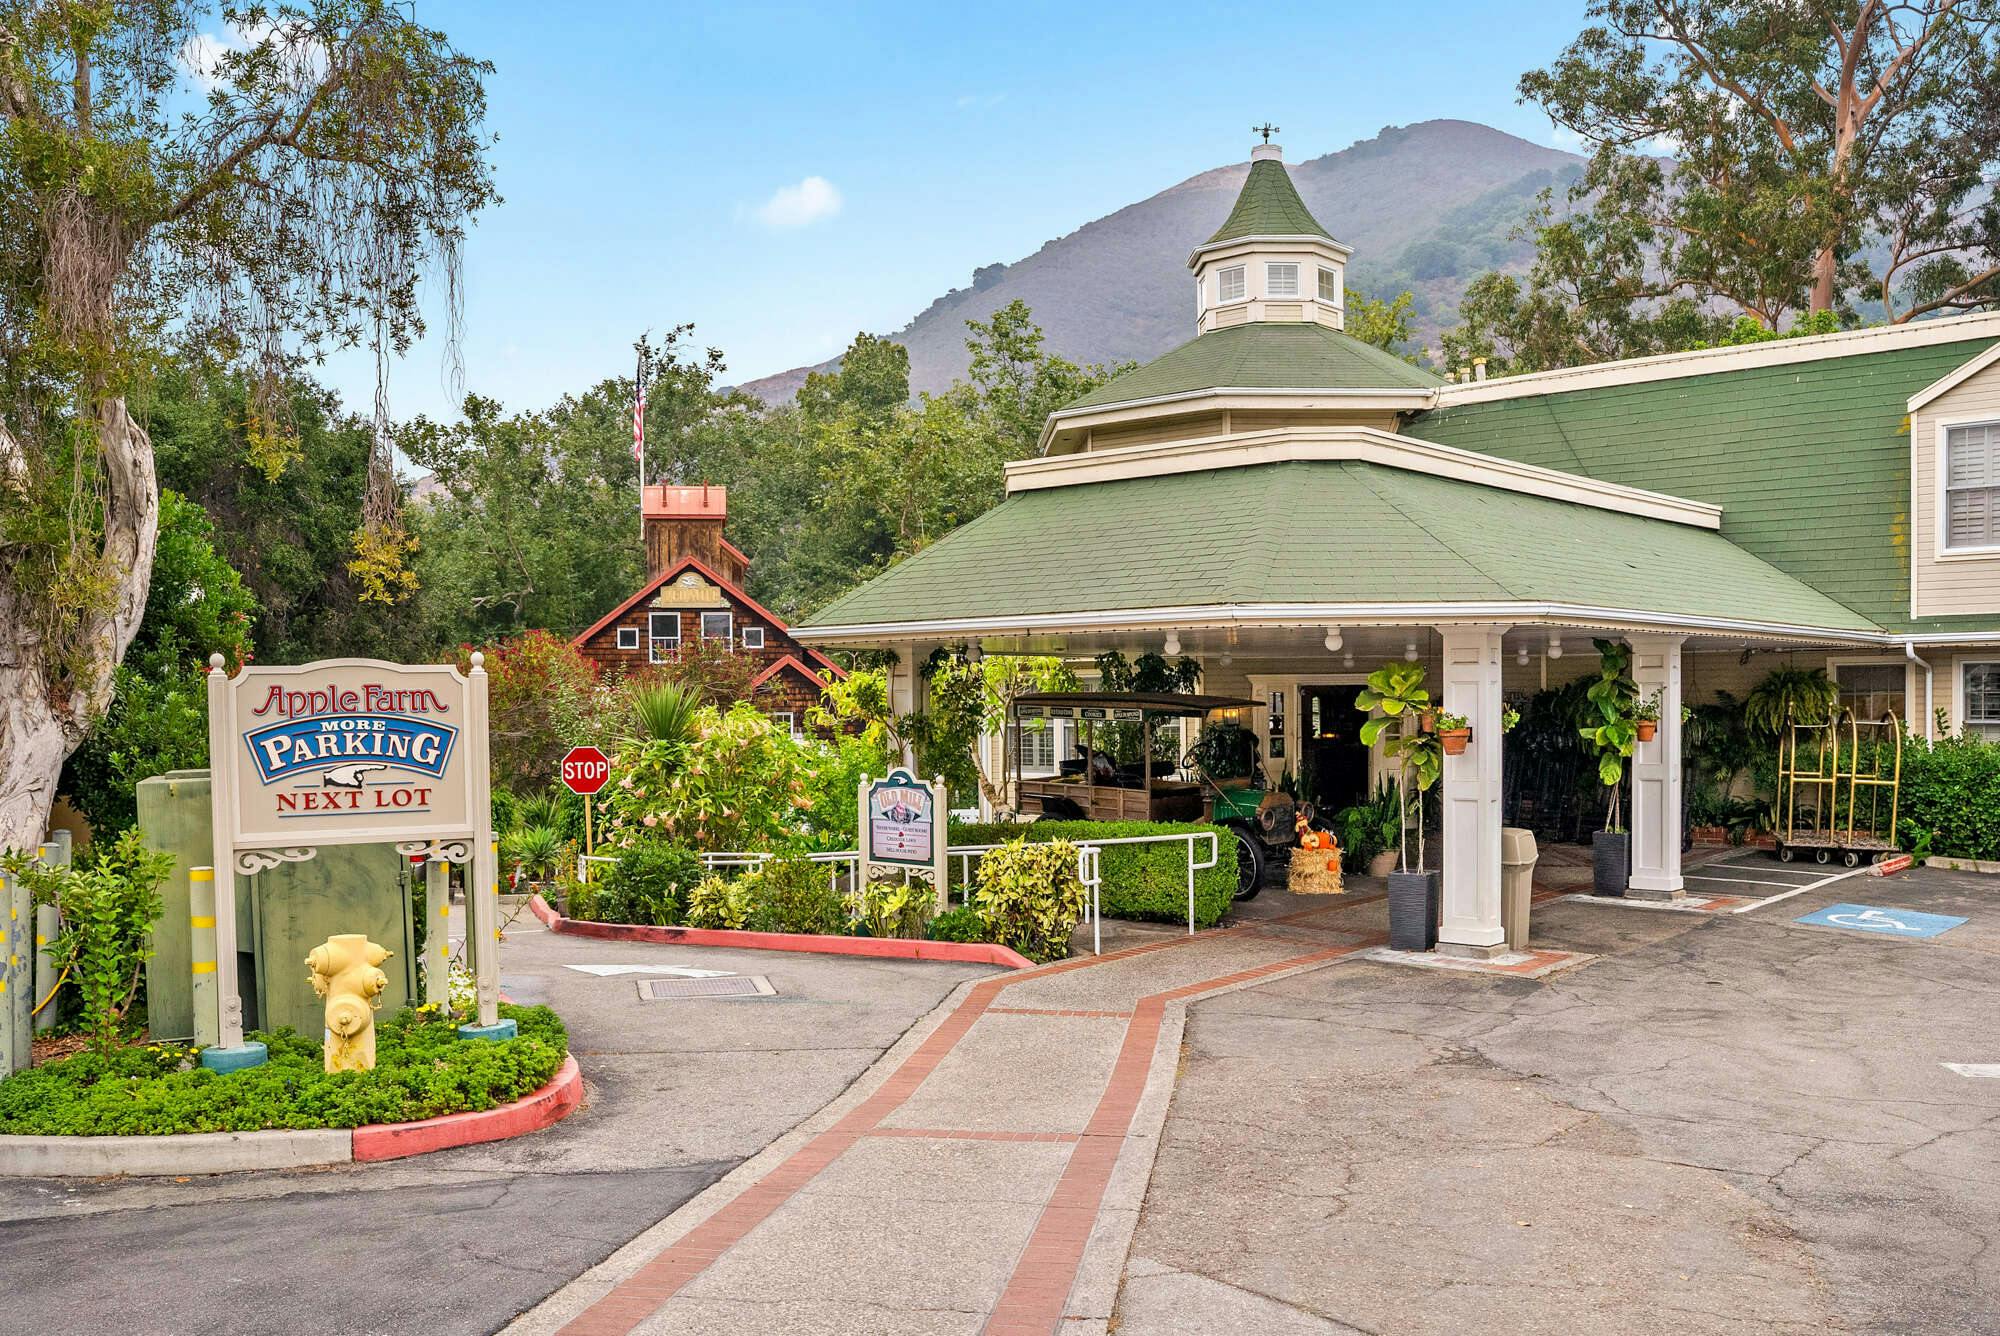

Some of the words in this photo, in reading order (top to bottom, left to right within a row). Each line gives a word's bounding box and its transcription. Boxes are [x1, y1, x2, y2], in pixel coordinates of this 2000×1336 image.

[252, 684, 359, 719] Apple
[362, 683, 449, 714] Farm
[320, 719, 386, 732] MORE
[260, 731, 441, 770] PARKING
[564, 761, 607, 780] STOP
[276, 790, 363, 812] NEXT
[375, 788, 432, 808] LOT
